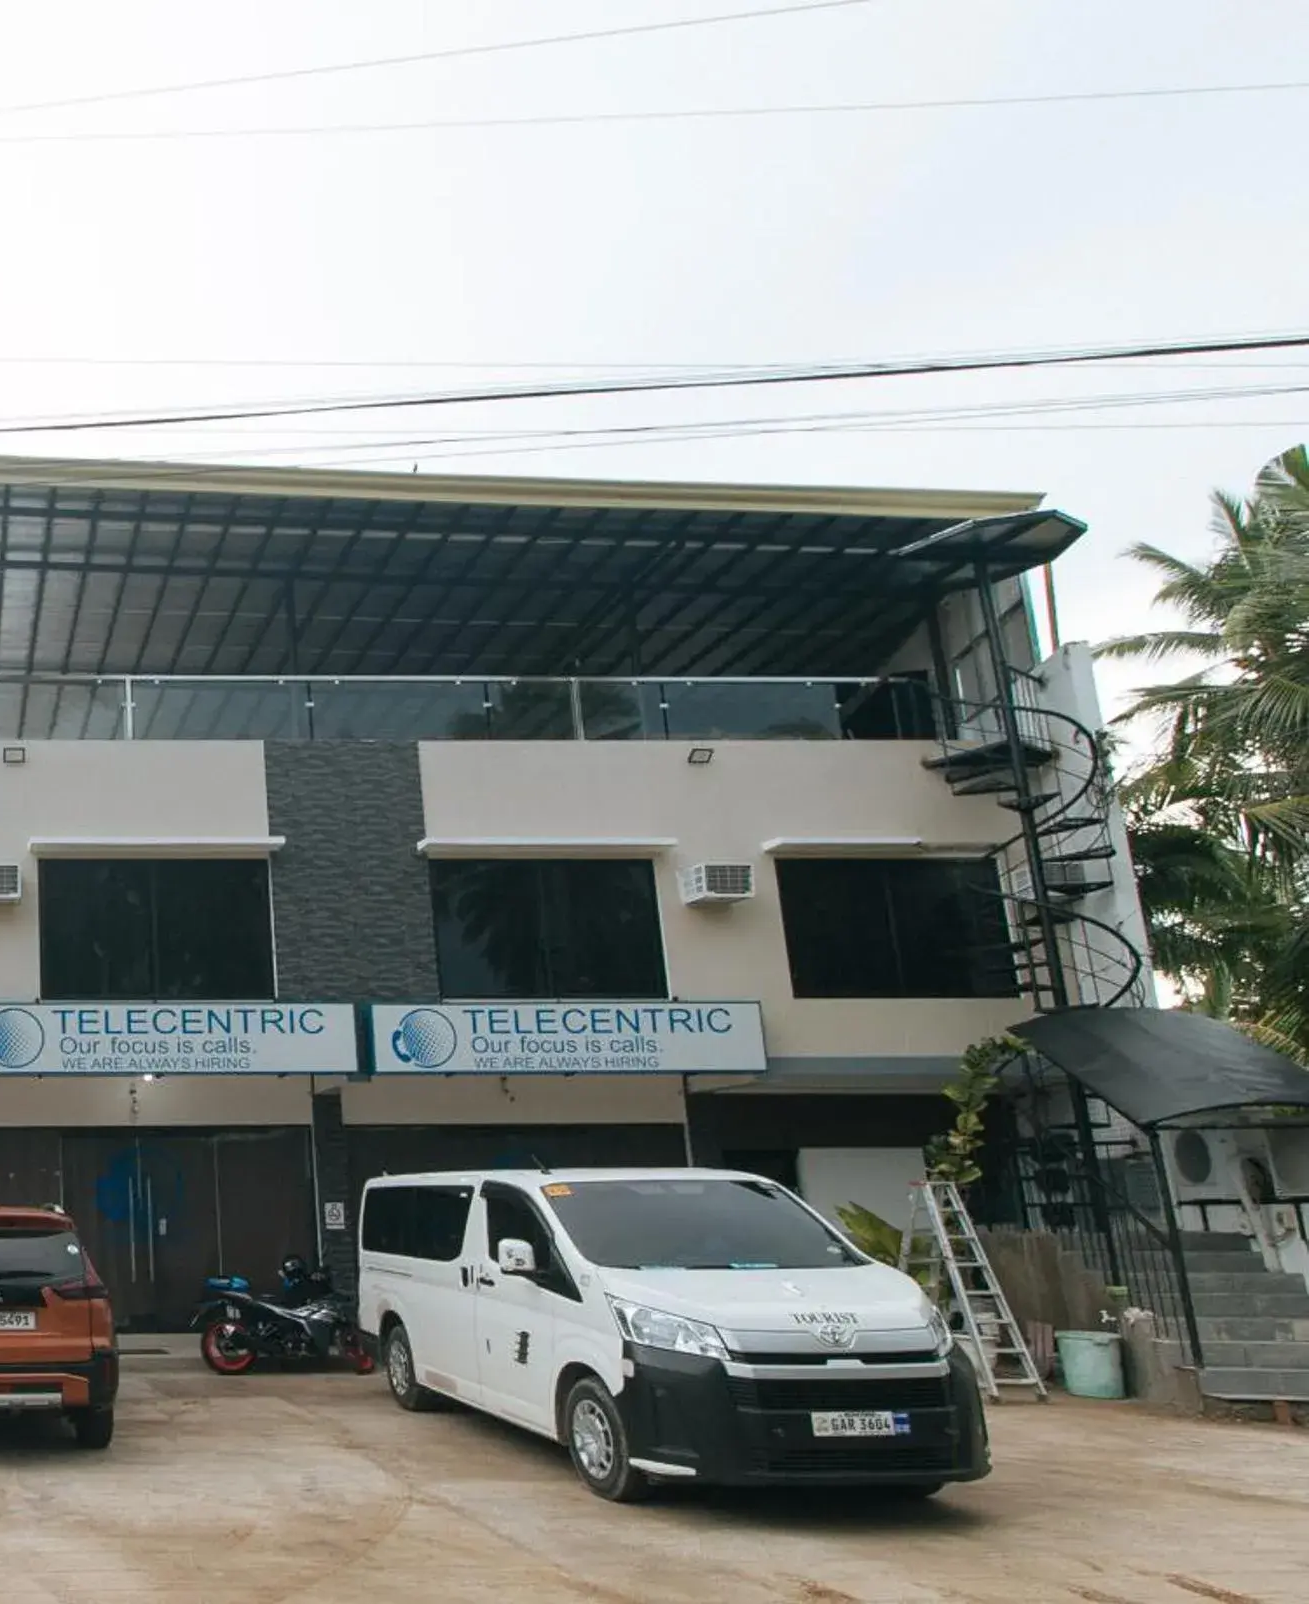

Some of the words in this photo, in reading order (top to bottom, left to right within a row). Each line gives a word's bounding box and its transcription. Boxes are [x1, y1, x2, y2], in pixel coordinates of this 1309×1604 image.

[51, 1008, 324, 1034] TELECENTRIC
[462, 1008, 732, 1034] TELECENTRIC
[60, 1036, 100, 1055] Our
[111, 1036, 169, 1055] focus
[177, 1036, 194, 1055] is
[202, 1036, 257, 1054] calls.
[472, 1036, 510, 1054] Our
[520, 1036, 578, 1053] focus
[586, 1036, 602, 1053] is
[610, 1036, 663, 1053] calls.
[62, 1057, 86, 1069] WE
[91, 1057, 124, 1069] ARE
[129, 1057, 191, 1069] ALWAYS
[195, 1057, 250, 1069] HIRING
[474, 1057, 499, 1069] WE
[503, 1057, 535, 1068] ARE
[539, 1057, 602, 1068] ALWAYS
[605, 1056, 659, 1068] HIRING
[0, 1313, 30, 1326] 5491
[789, 1311, 859, 1324] TOURIST
[831, 1418, 856, 1431] GAR
[859, 1418, 891, 1431] 3604
